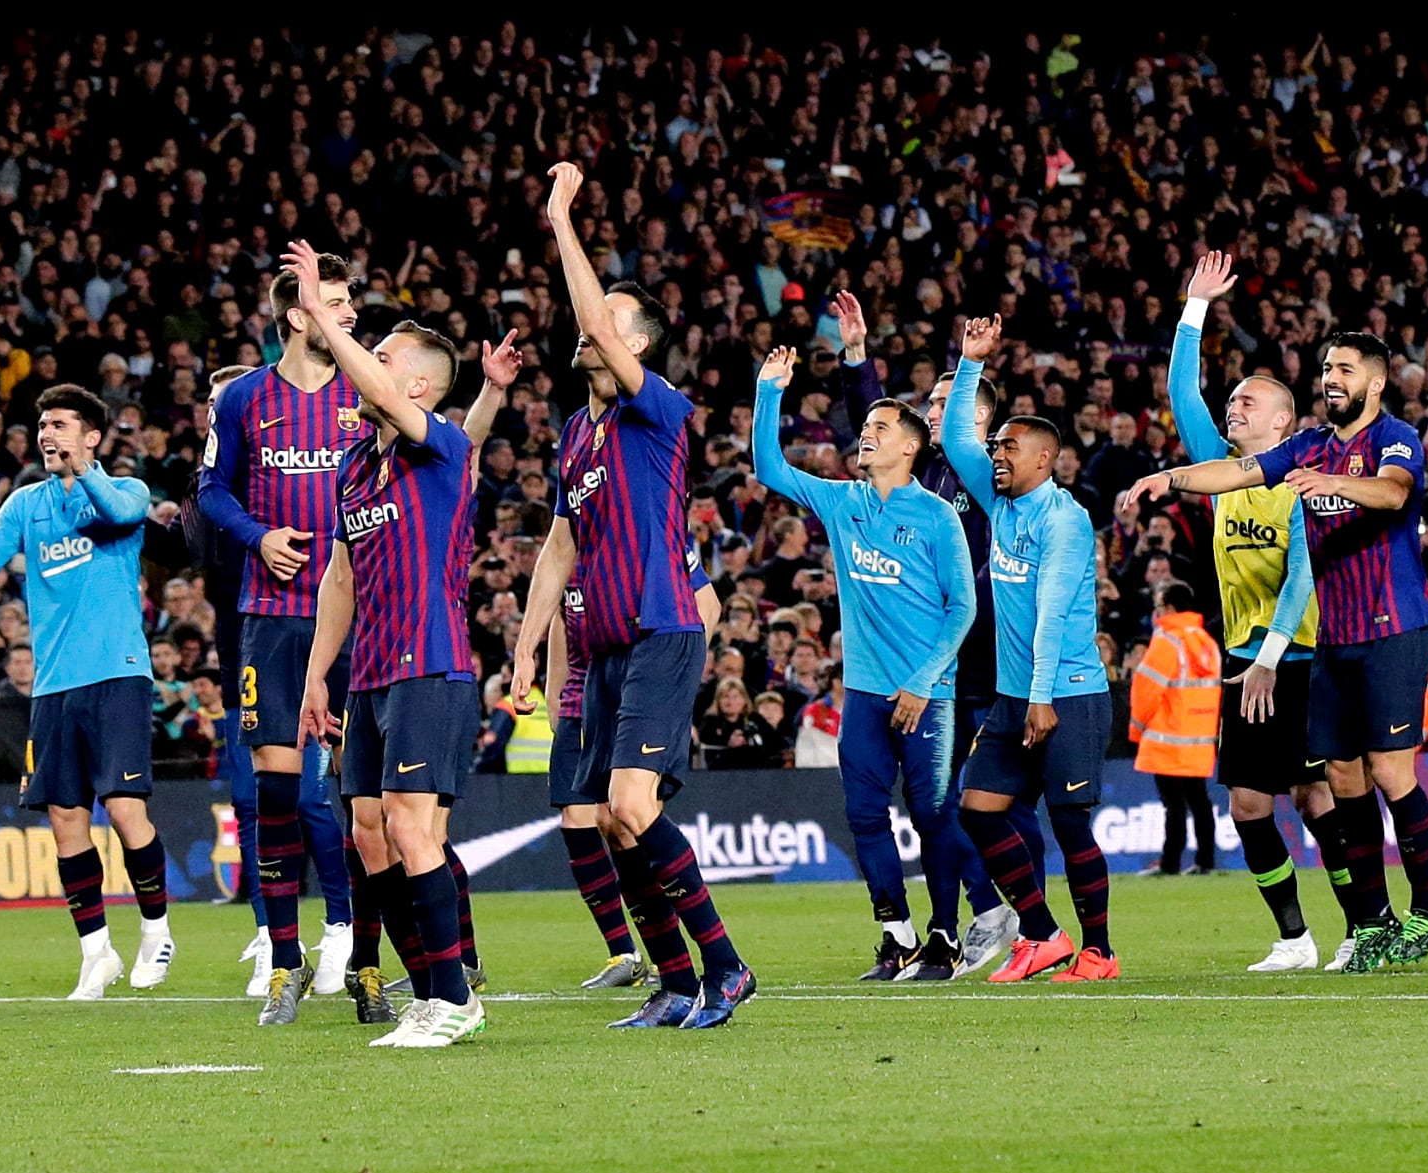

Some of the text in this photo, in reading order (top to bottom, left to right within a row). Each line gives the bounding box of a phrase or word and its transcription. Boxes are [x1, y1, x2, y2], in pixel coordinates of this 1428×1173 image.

[260, 445, 344, 469] Rakute
[344, 502, 399, 533] kuten
[1225, 514, 1277, 542] beko
[38, 536, 93, 563] beko
[852, 541, 902, 578] beko
[678, 813, 827, 866] akuten
